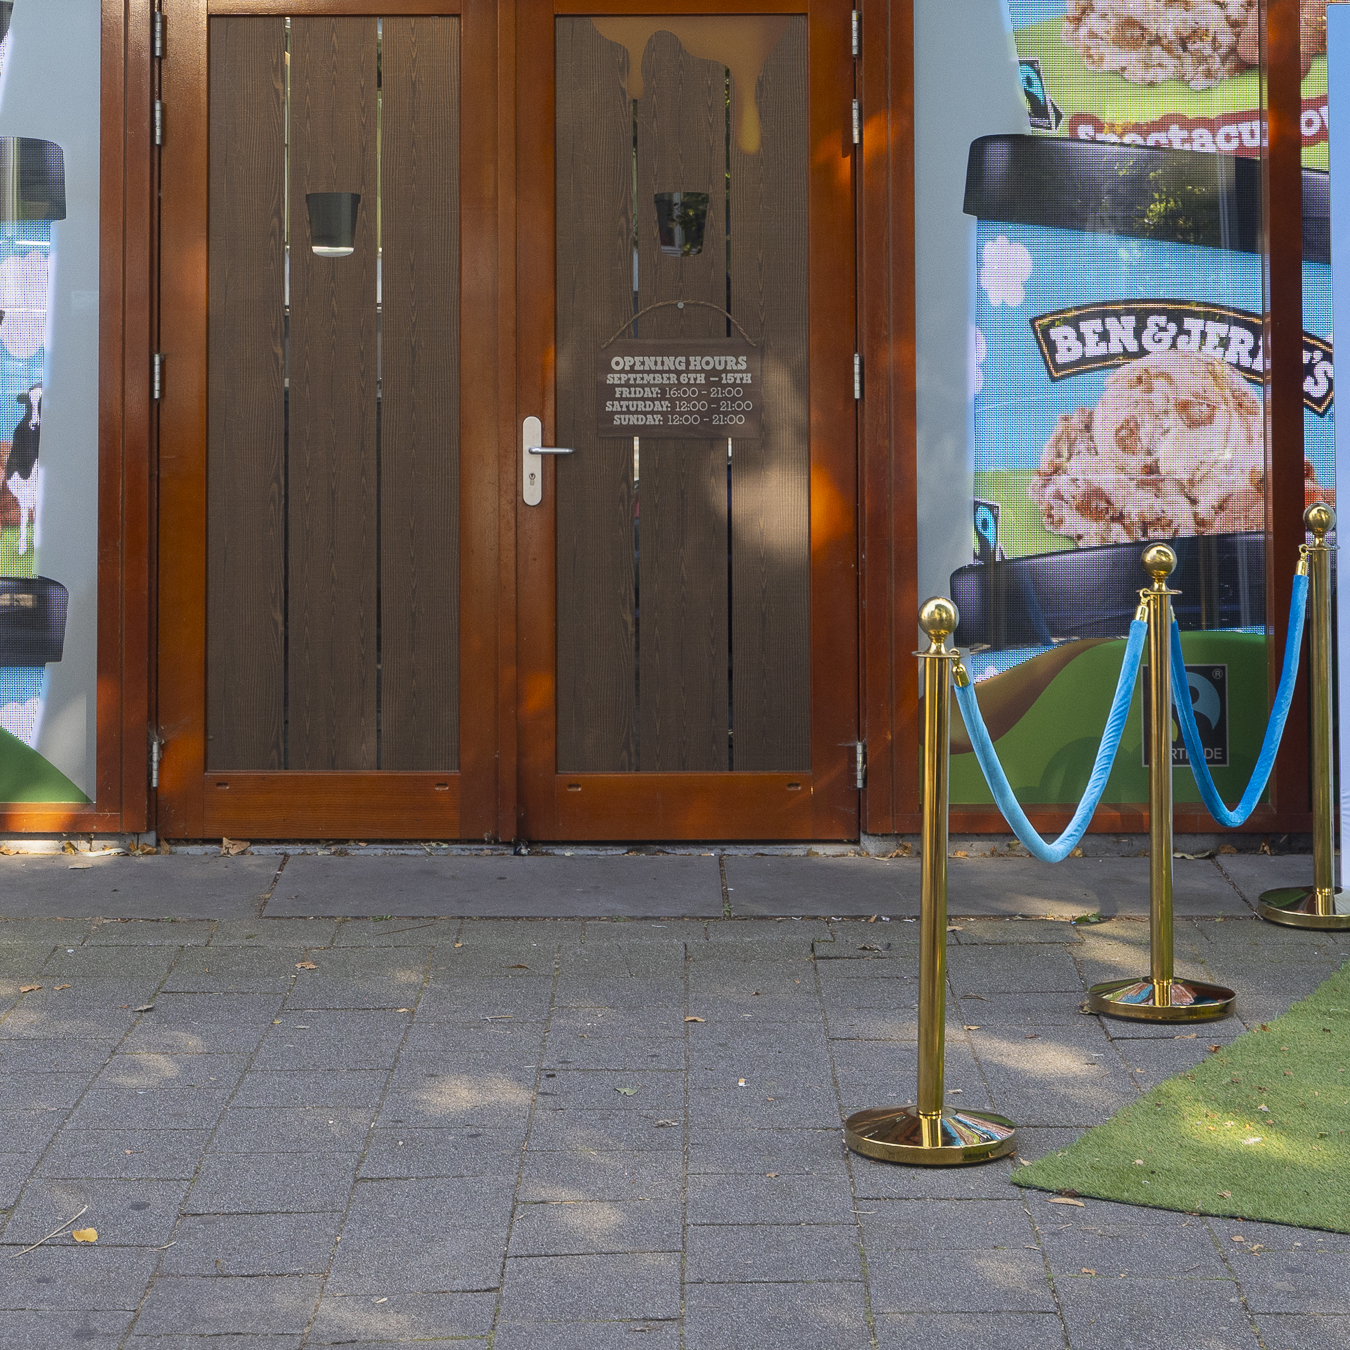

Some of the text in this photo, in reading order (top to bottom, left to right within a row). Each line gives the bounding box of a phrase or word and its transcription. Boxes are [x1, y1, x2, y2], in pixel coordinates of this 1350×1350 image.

[611, 356, 747, 371] OPENING HOURS
[606, 373, 677, 384] SEPTEMBER
[680, 373, 705, 384] 6TH
[721, 373, 752, 384] 15TH
[615, 387, 661, 398] FRIDAY:
[665, 387, 699, 398] 16:00
[710, 387, 743, 398] 21:00
[605, 401, 671, 412] SATURDAY:
[675, 401, 708, 411] 12:00
[719, 401, 753, 411] 21:00
[613, 414, 664, 425] SUNDAY:
[667, 414, 700, 425] 12:00
[712, 414, 745, 425] 21:00
